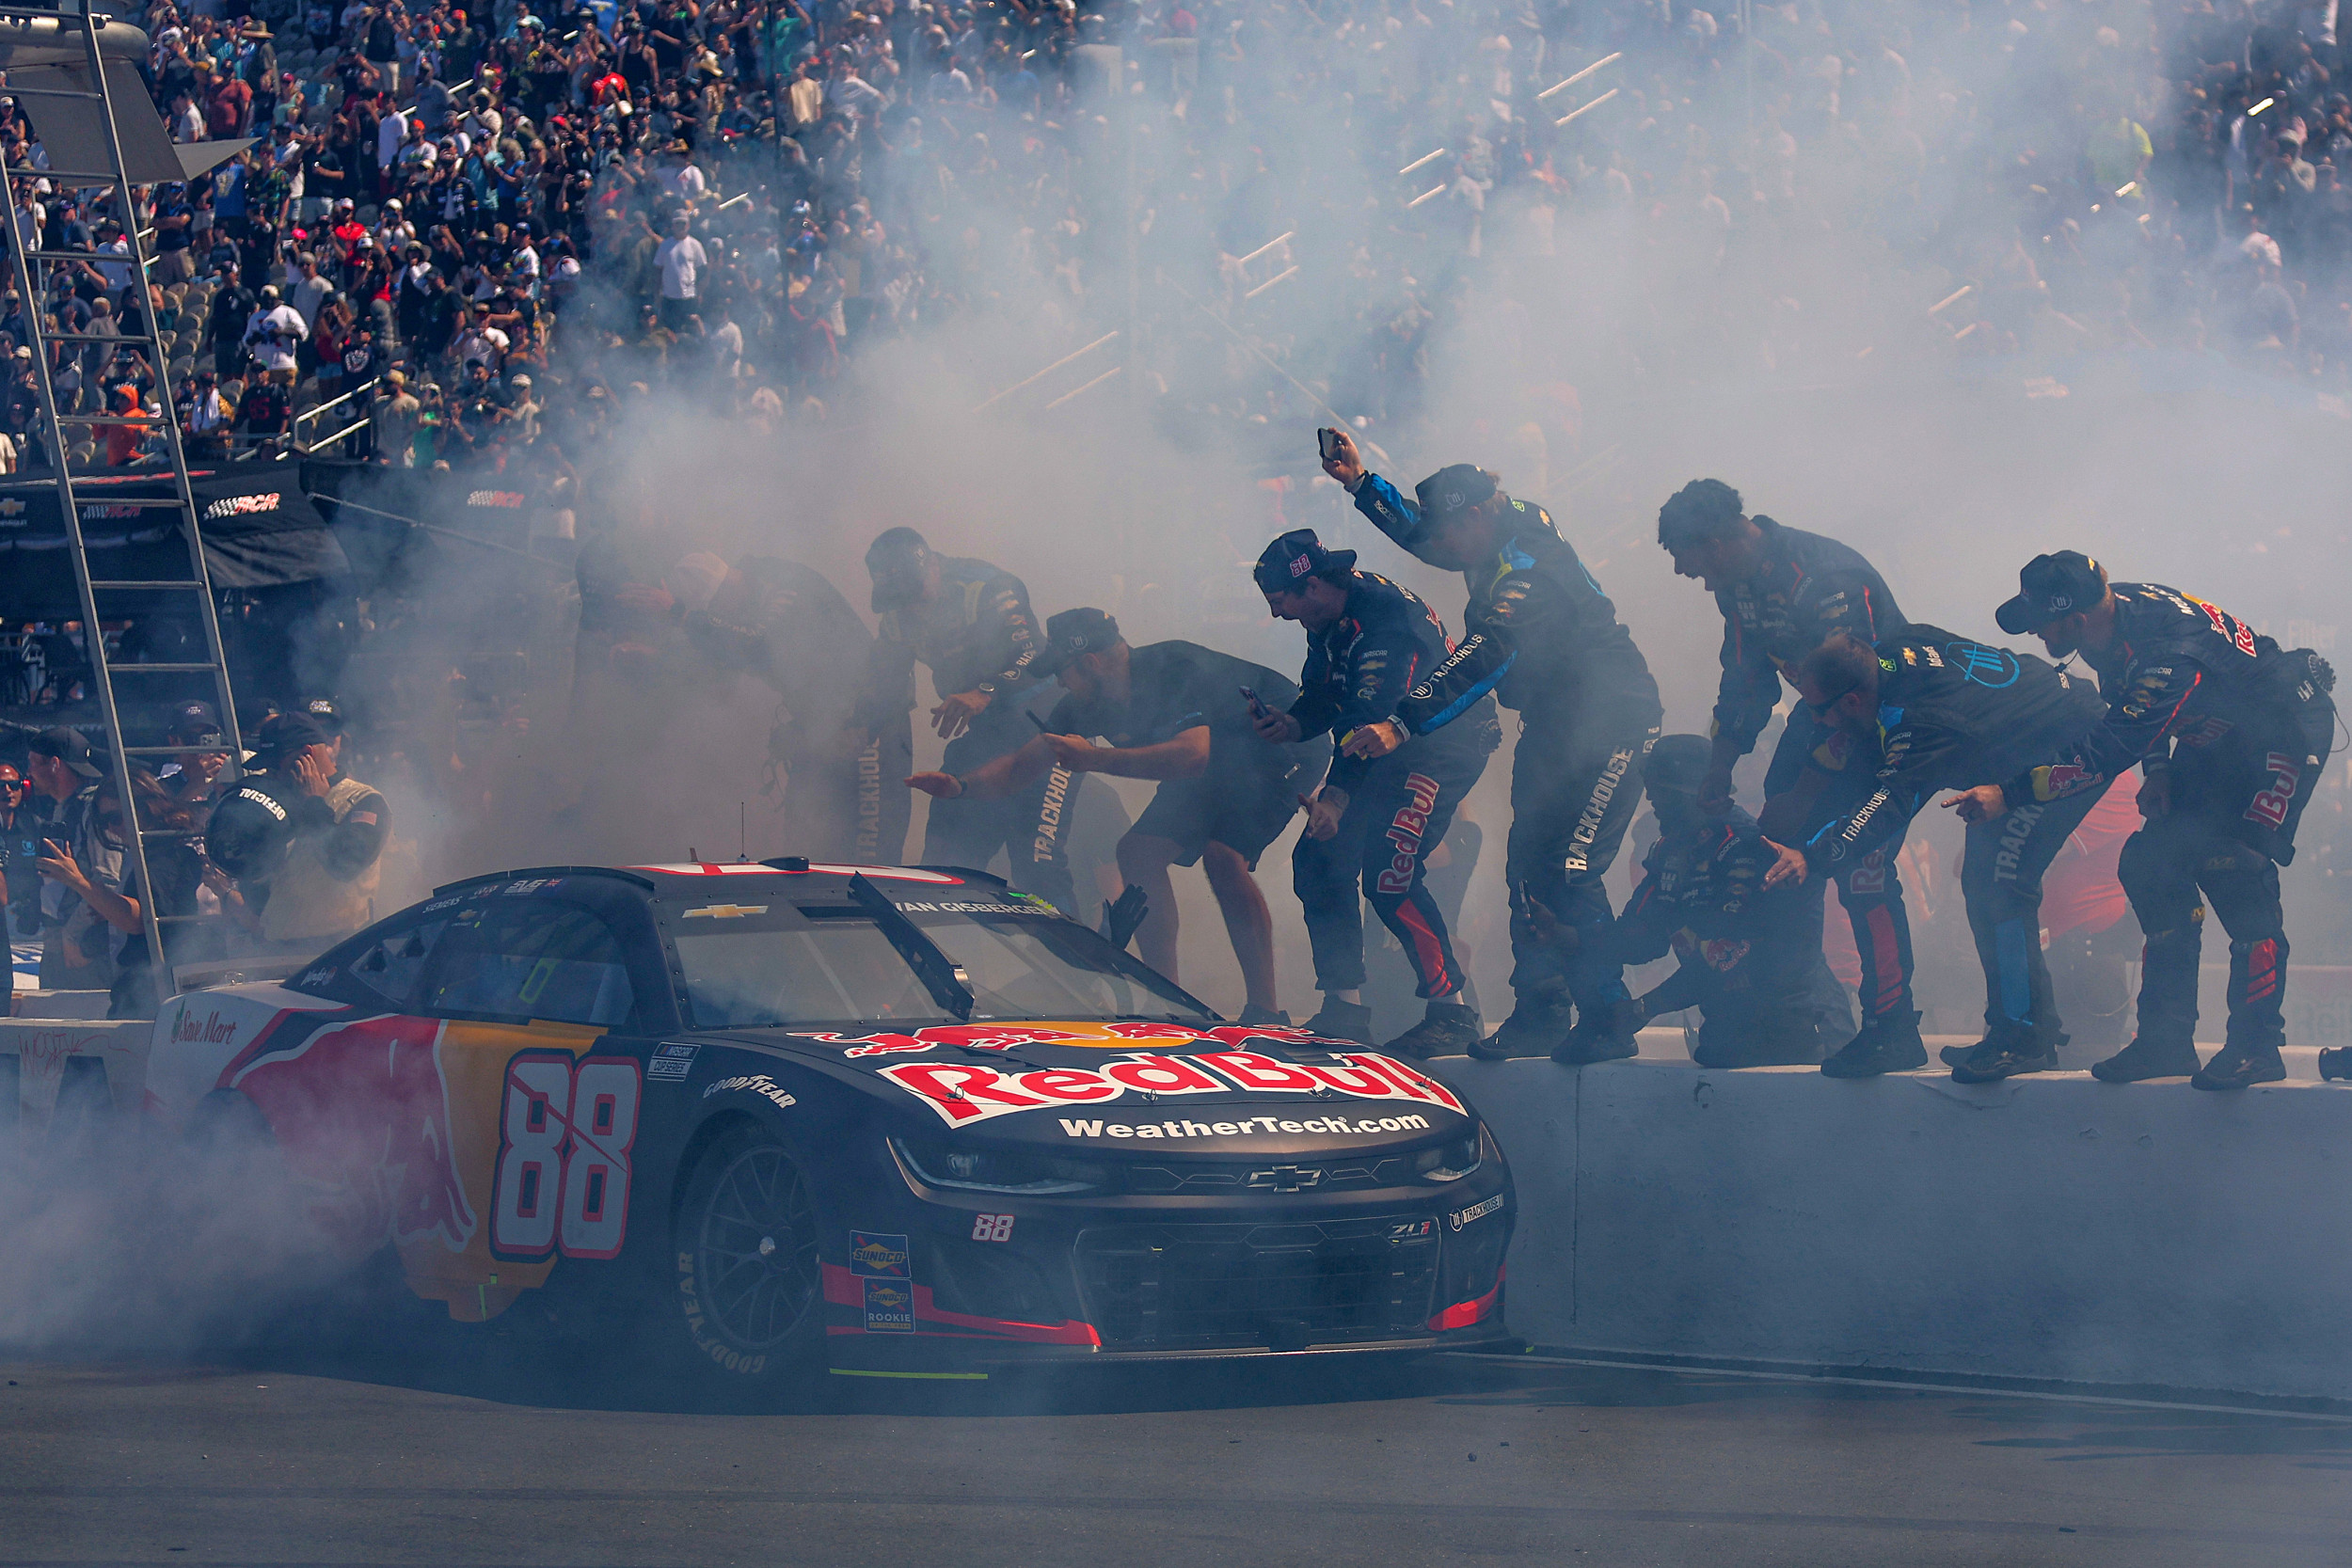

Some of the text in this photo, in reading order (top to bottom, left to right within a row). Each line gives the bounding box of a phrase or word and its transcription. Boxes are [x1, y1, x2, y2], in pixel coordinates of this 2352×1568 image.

[1289, 553, 1311, 578] 88
[238, 786, 286, 821] OFFICIAL
[1850, 842, 1889, 895] Re
[422, 896, 463, 913] SIEMENS
[653, 1061, 687, 1073] CUP SERIES
[703, 1074, 798, 1109] GOODYEAR
[490, 1050, 642, 1262] 88
[1465, 1195, 1499, 1221] TRACKHOUSE
[972, 1214, 1015, 1242] 88
[853, 1248, 905, 1263] SUNOCO
[868, 1291, 909, 1303] SUNOCO
[868, 1312, 912, 1323] ROOKIE
